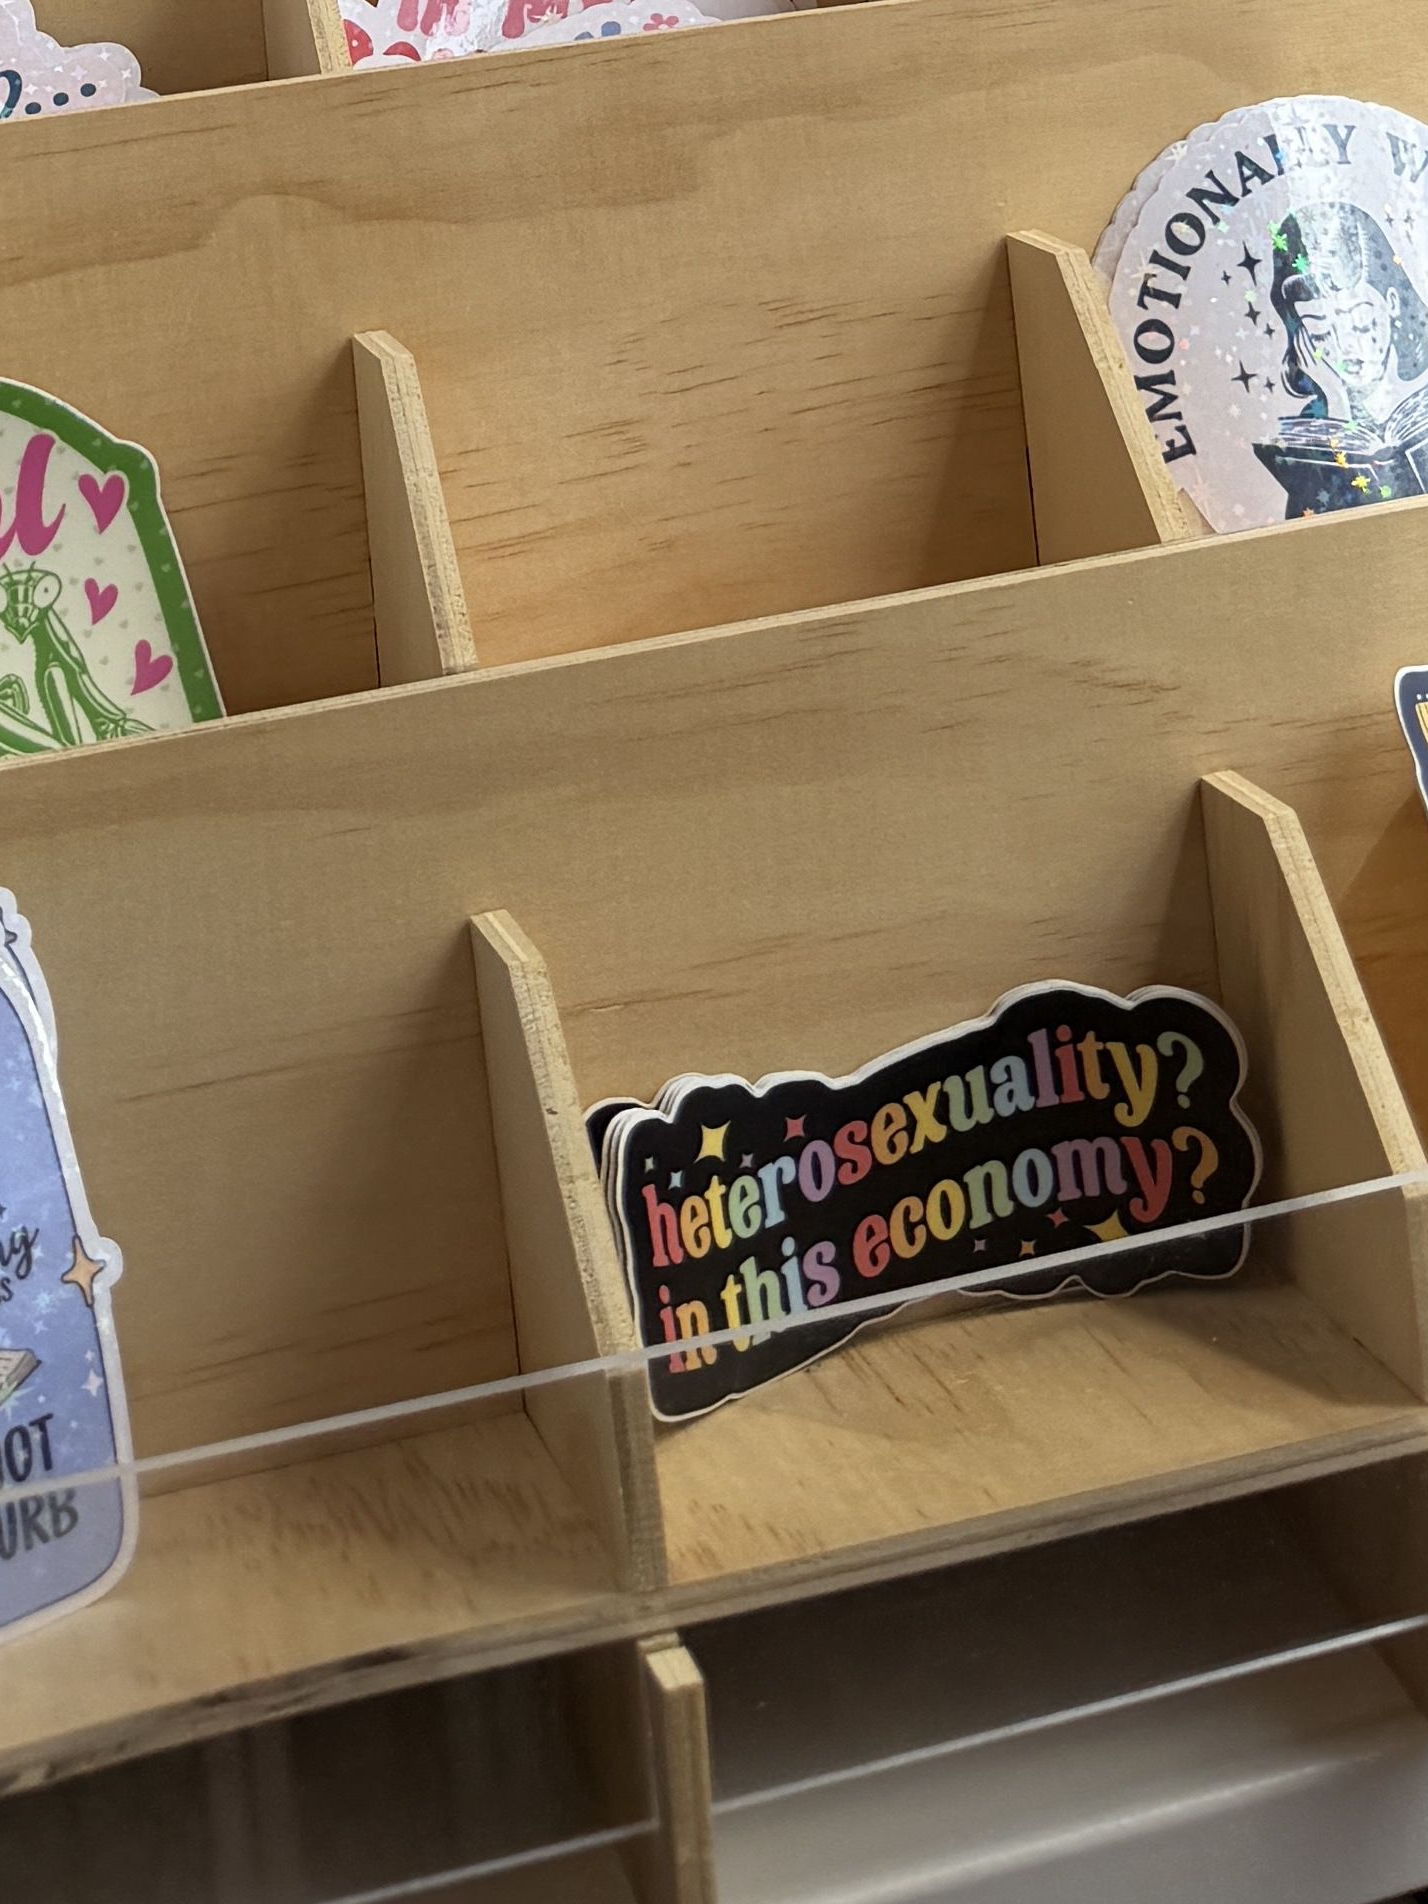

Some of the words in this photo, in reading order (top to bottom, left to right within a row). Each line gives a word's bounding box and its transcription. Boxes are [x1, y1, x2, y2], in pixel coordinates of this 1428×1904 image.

[642, 1024, 1205, 1269] heterosexuality?
[659, 1284, 718, 1374] in
[720, 1236, 842, 1353] this
[852, 1124, 1220, 1279] economy?
